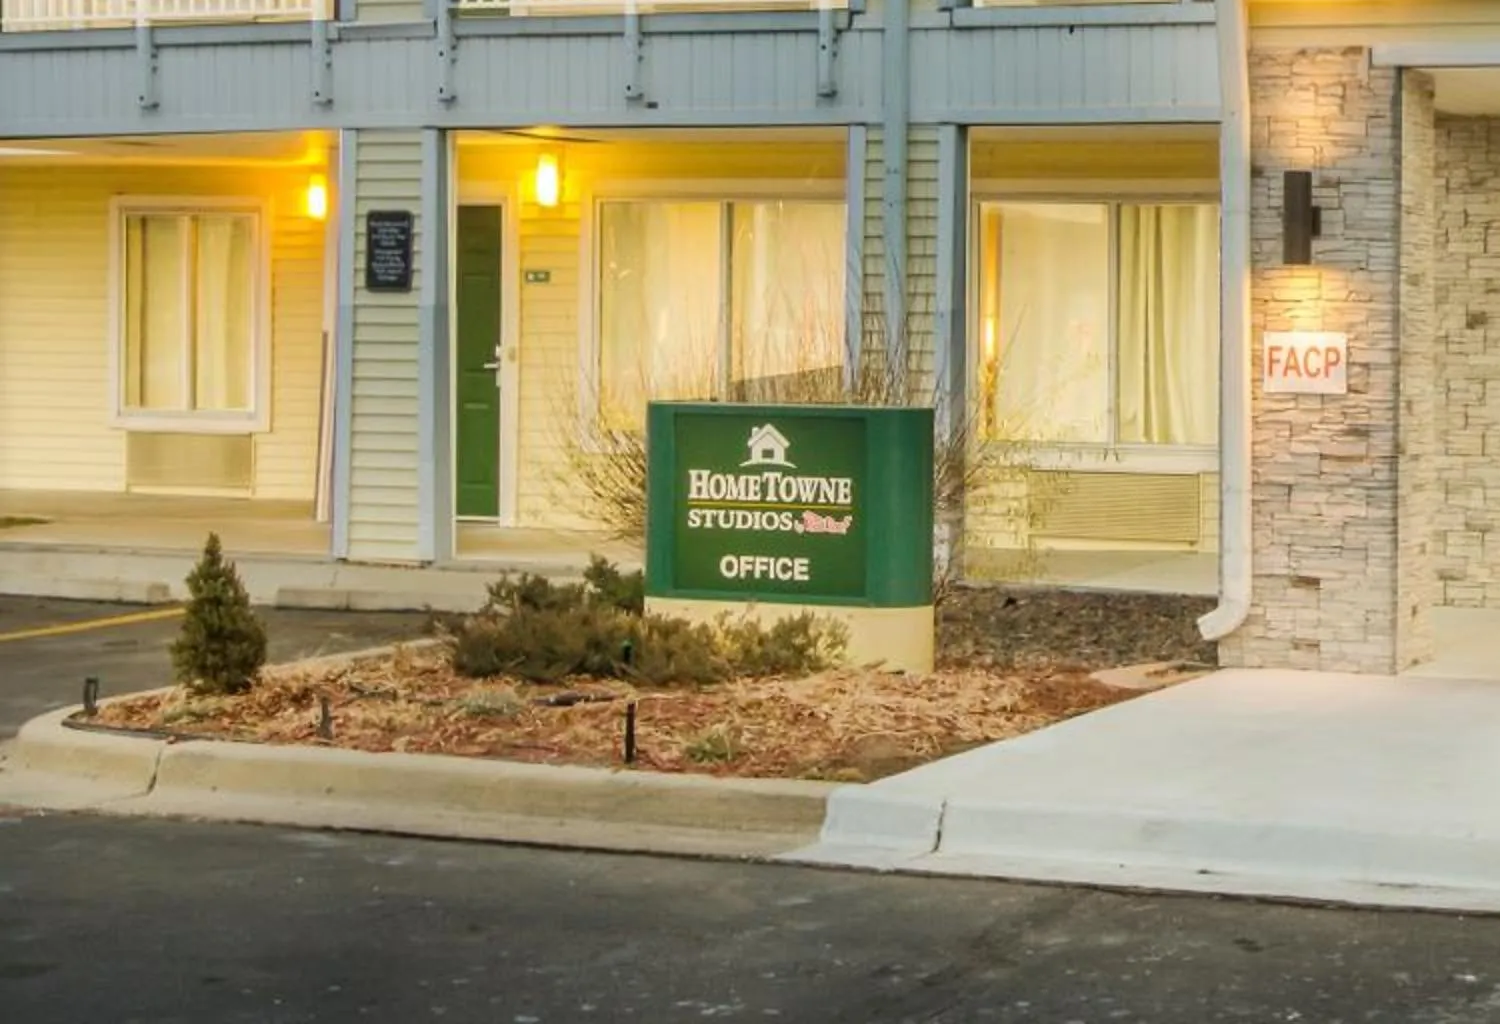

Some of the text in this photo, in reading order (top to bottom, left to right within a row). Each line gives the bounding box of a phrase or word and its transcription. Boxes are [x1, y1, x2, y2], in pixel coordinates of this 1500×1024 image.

[1267, 344, 1341, 379] FACP
[687, 469, 853, 504] HOMETOWNE
[687, 508, 793, 532] STUDIOS
[719, 554, 811, 581] OFFICE
